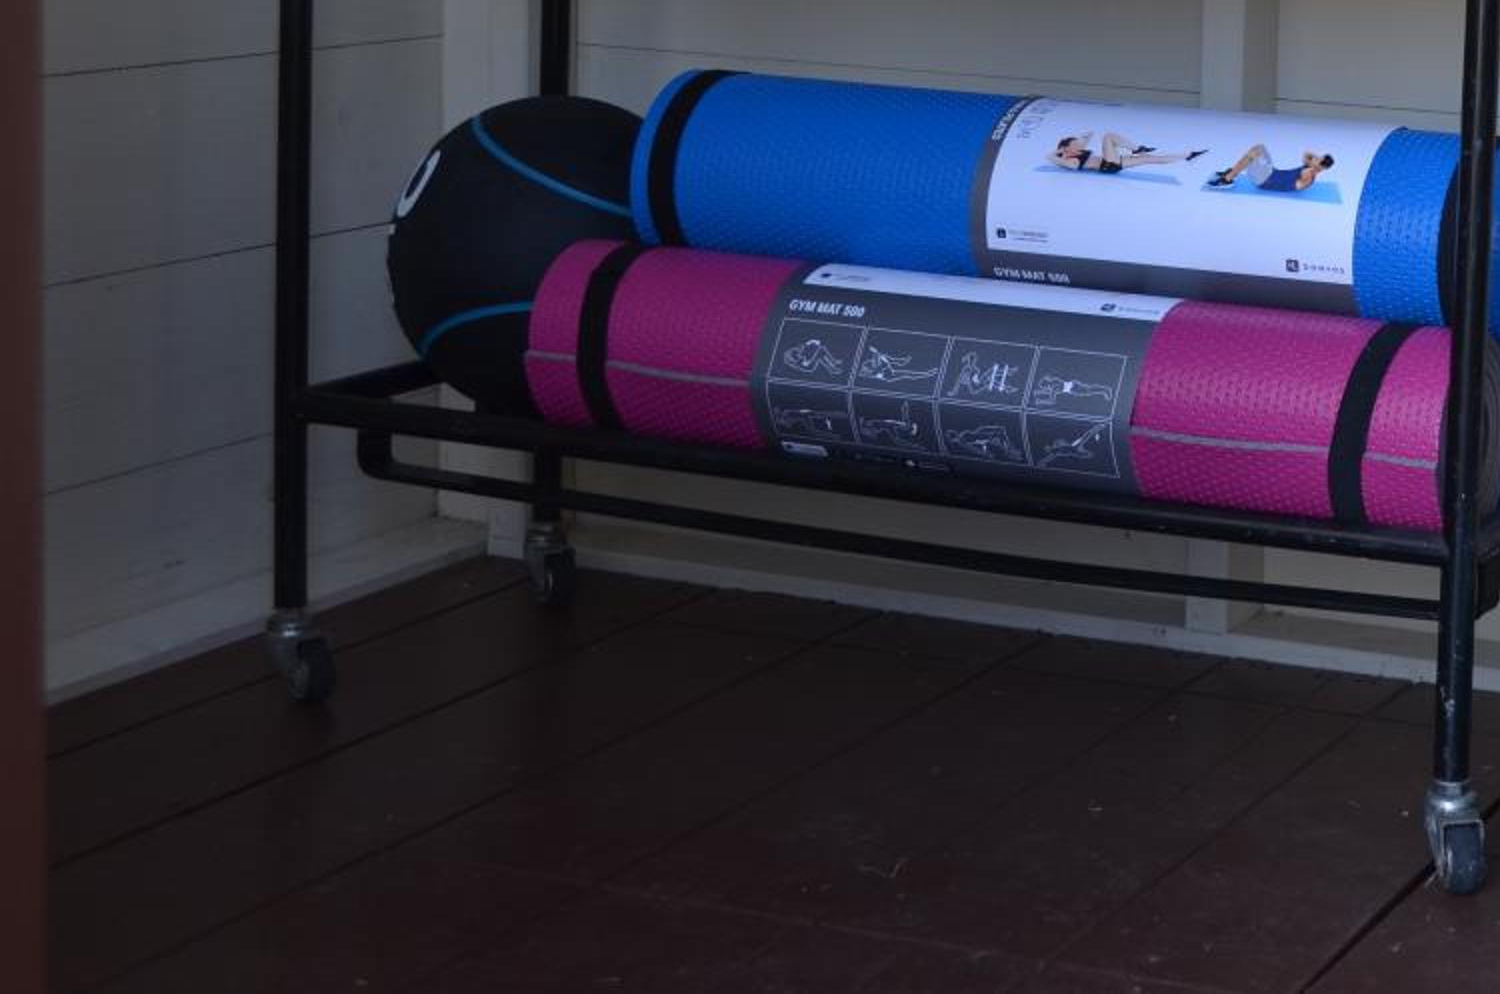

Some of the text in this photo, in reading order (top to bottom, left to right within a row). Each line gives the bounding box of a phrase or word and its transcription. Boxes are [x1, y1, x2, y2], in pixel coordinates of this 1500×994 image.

[789, 298, 866, 319] GYM MAT 500
